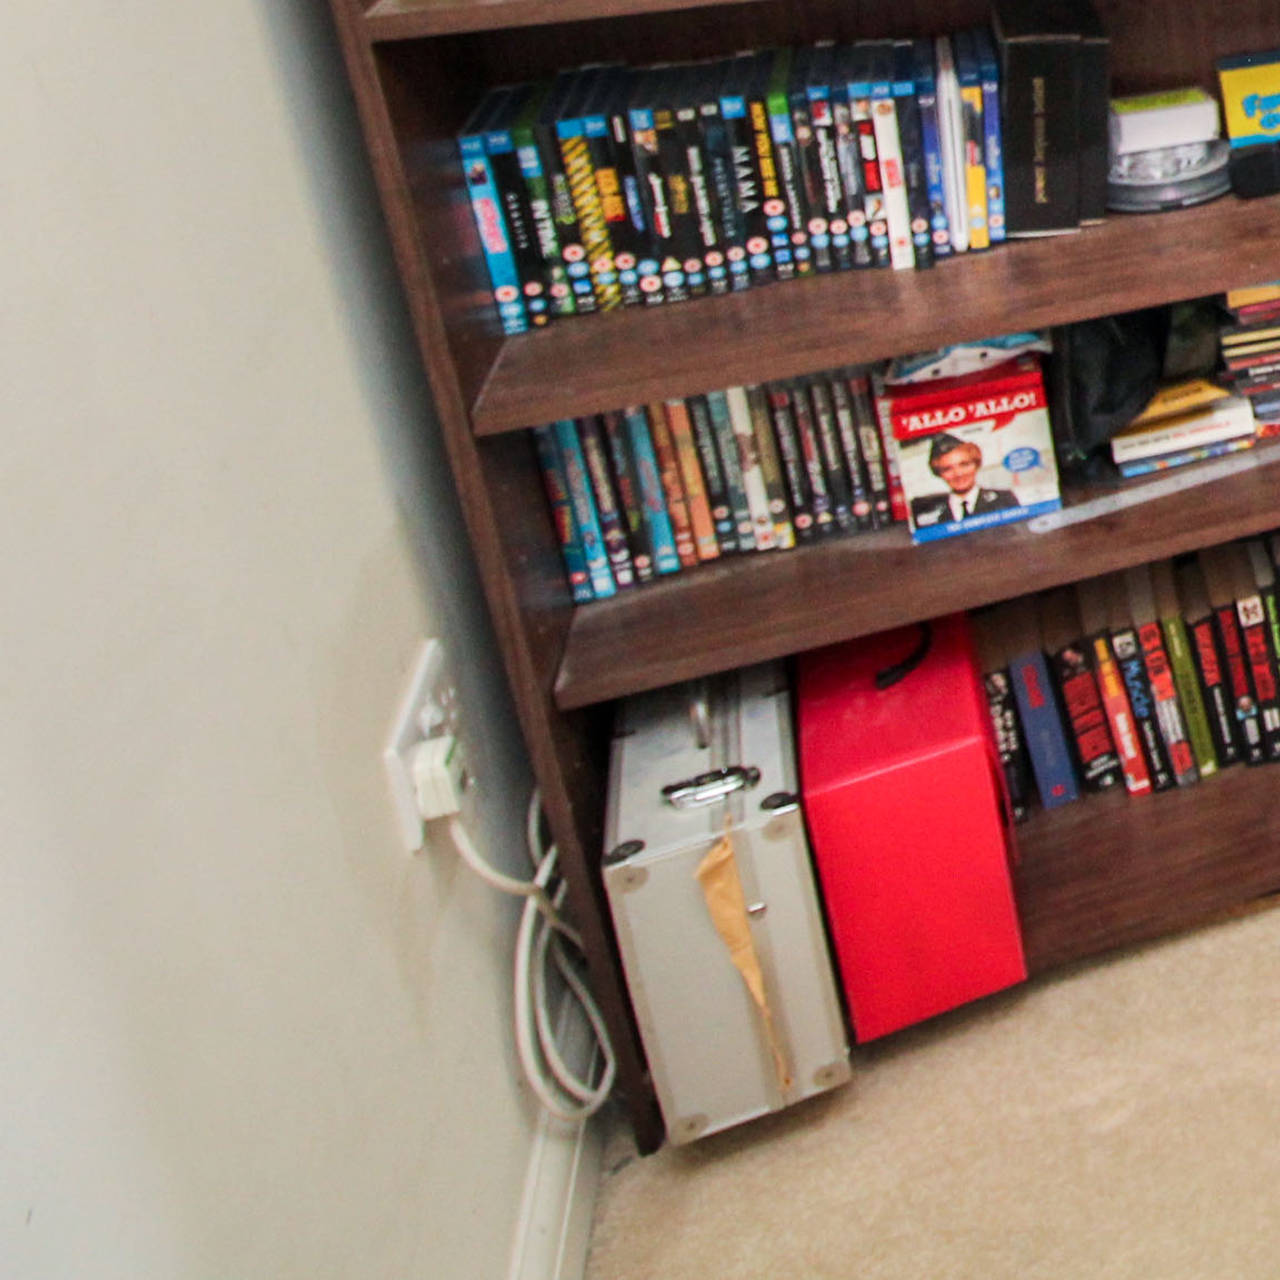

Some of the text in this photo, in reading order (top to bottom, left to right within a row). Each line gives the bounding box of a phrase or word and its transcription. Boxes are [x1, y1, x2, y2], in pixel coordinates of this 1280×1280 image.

[732, 145, 760, 215] MAMA
[750, 101, 779, 199] NOW YOU SEE ME
[901, 391, 1036, 432] 'ALLO 'ALLO!
